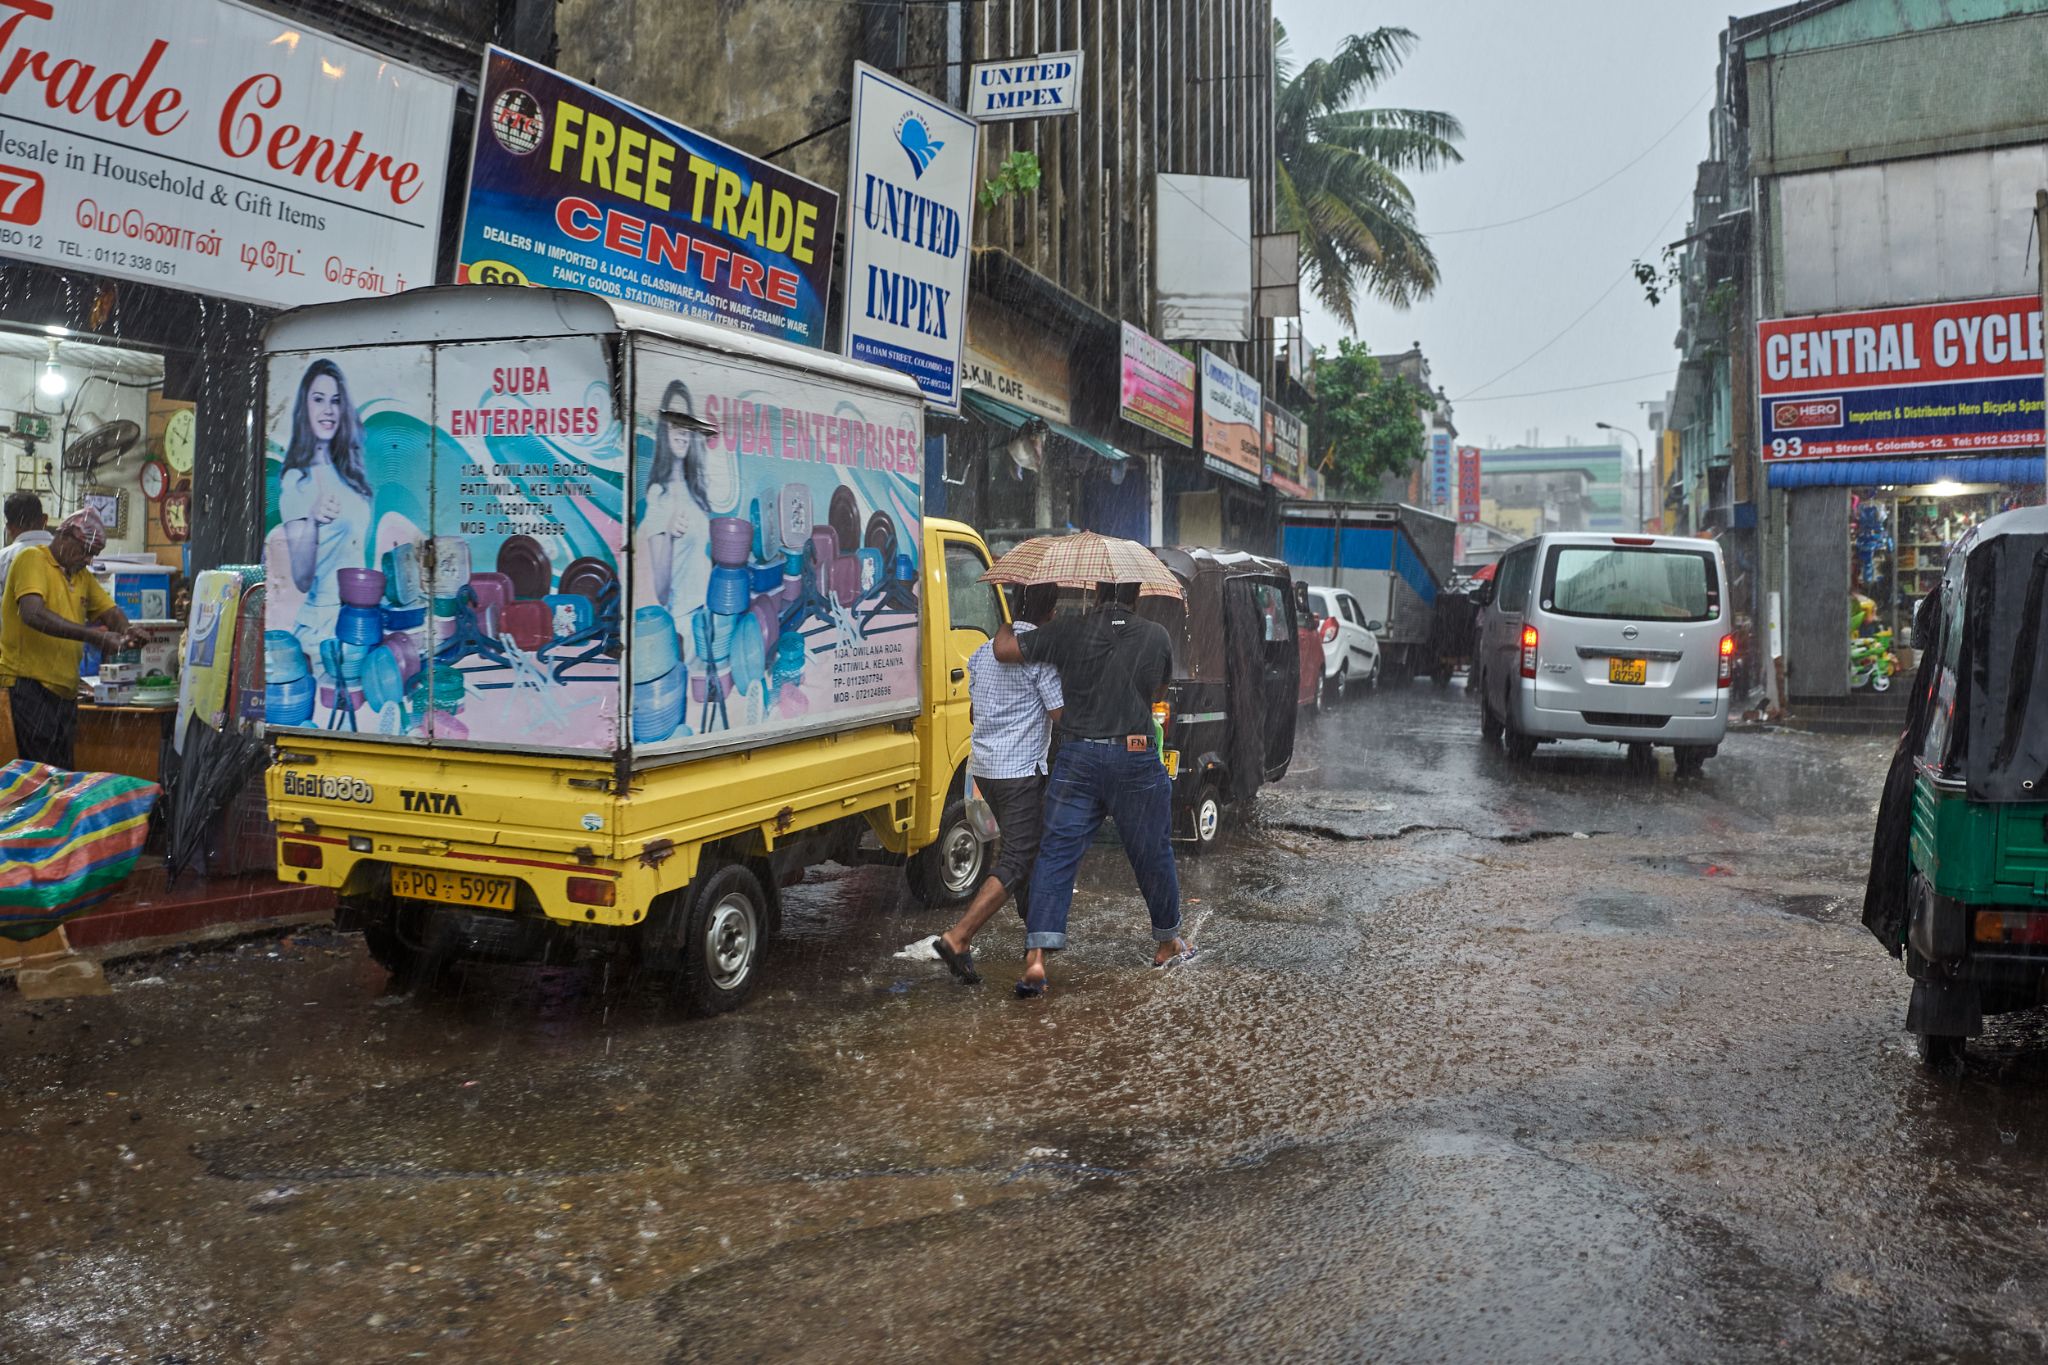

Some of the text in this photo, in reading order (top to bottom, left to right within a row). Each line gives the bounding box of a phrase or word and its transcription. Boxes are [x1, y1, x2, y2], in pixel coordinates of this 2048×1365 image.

[980, 62, 1071, 86] UNITED
[0, 0, 424, 204] Trade Centre
[985, 87, 1063, 110] IMPEX
[65, 146, 85, 171] in
[92, 153, 203, 200] Household
[210, 184, 228, 206] &
[235, 189, 272, 218] Gift
[277, 206, 326, 231] Items
[550, 100, 818, 264] FREE TRADE
[864, 173, 961, 259] UNITED
[27, 235, 43, 249] 12
[95, 248, 126, 266] 0112
[129, 254, 152, 270] 338
[154, 260, 177, 275] 051
[483, 225, 532, 251] DEALERS
[534, 241, 546, 254] IN
[548, 245, 598, 271] IMPORTED
[600, 261, 608, 273] &
[609, 264, 639, 284] LOCAL
[555, 196, 799, 309] CENTRE
[553, 265, 586, 285] FANCY
[625, 286, 681, 313] STATIONERY
[691, 306, 713, 321] BABY
[865, 264, 951, 340] IMPEX
[856, 342, 865, 352] 69
[1766, 311, 2044, 382] CENTRAL CYCLE
[492, 366, 550, 395] SUBA
[998, 375, 1023, 400] CAFE
[450, 406, 600, 437] ENTERPRISES
[1799, 404, 1837, 415] HERO
[1849, 408, 1891, 424] Importers
[1894, 407, 1901, 419] &
[1903, 404, 1956, 419] Distributors
[1958, 402, 1980, 415] Hero
[1983, 400, 2016, 416] Bicycle
[705, 394, 916, 474] SUBA ENTERPRISES
[1771, 437, 1802, 457] 93
[1808, 446, 1832, 454] Dam
[1974, 435, 1998, 445] 0112
[2000, 433, 2040, 444] 432183
[461, 502, 474, 515] TP
[460, 522, 486, 534] MOB
[1615, 671, 1641, 681] 8759
[833, 692, 849, 703] MOB
[400, 790, 462, 816] TATA
[412, 871, 436, 896] PQ
[460, 877, 511, 905] 5997
